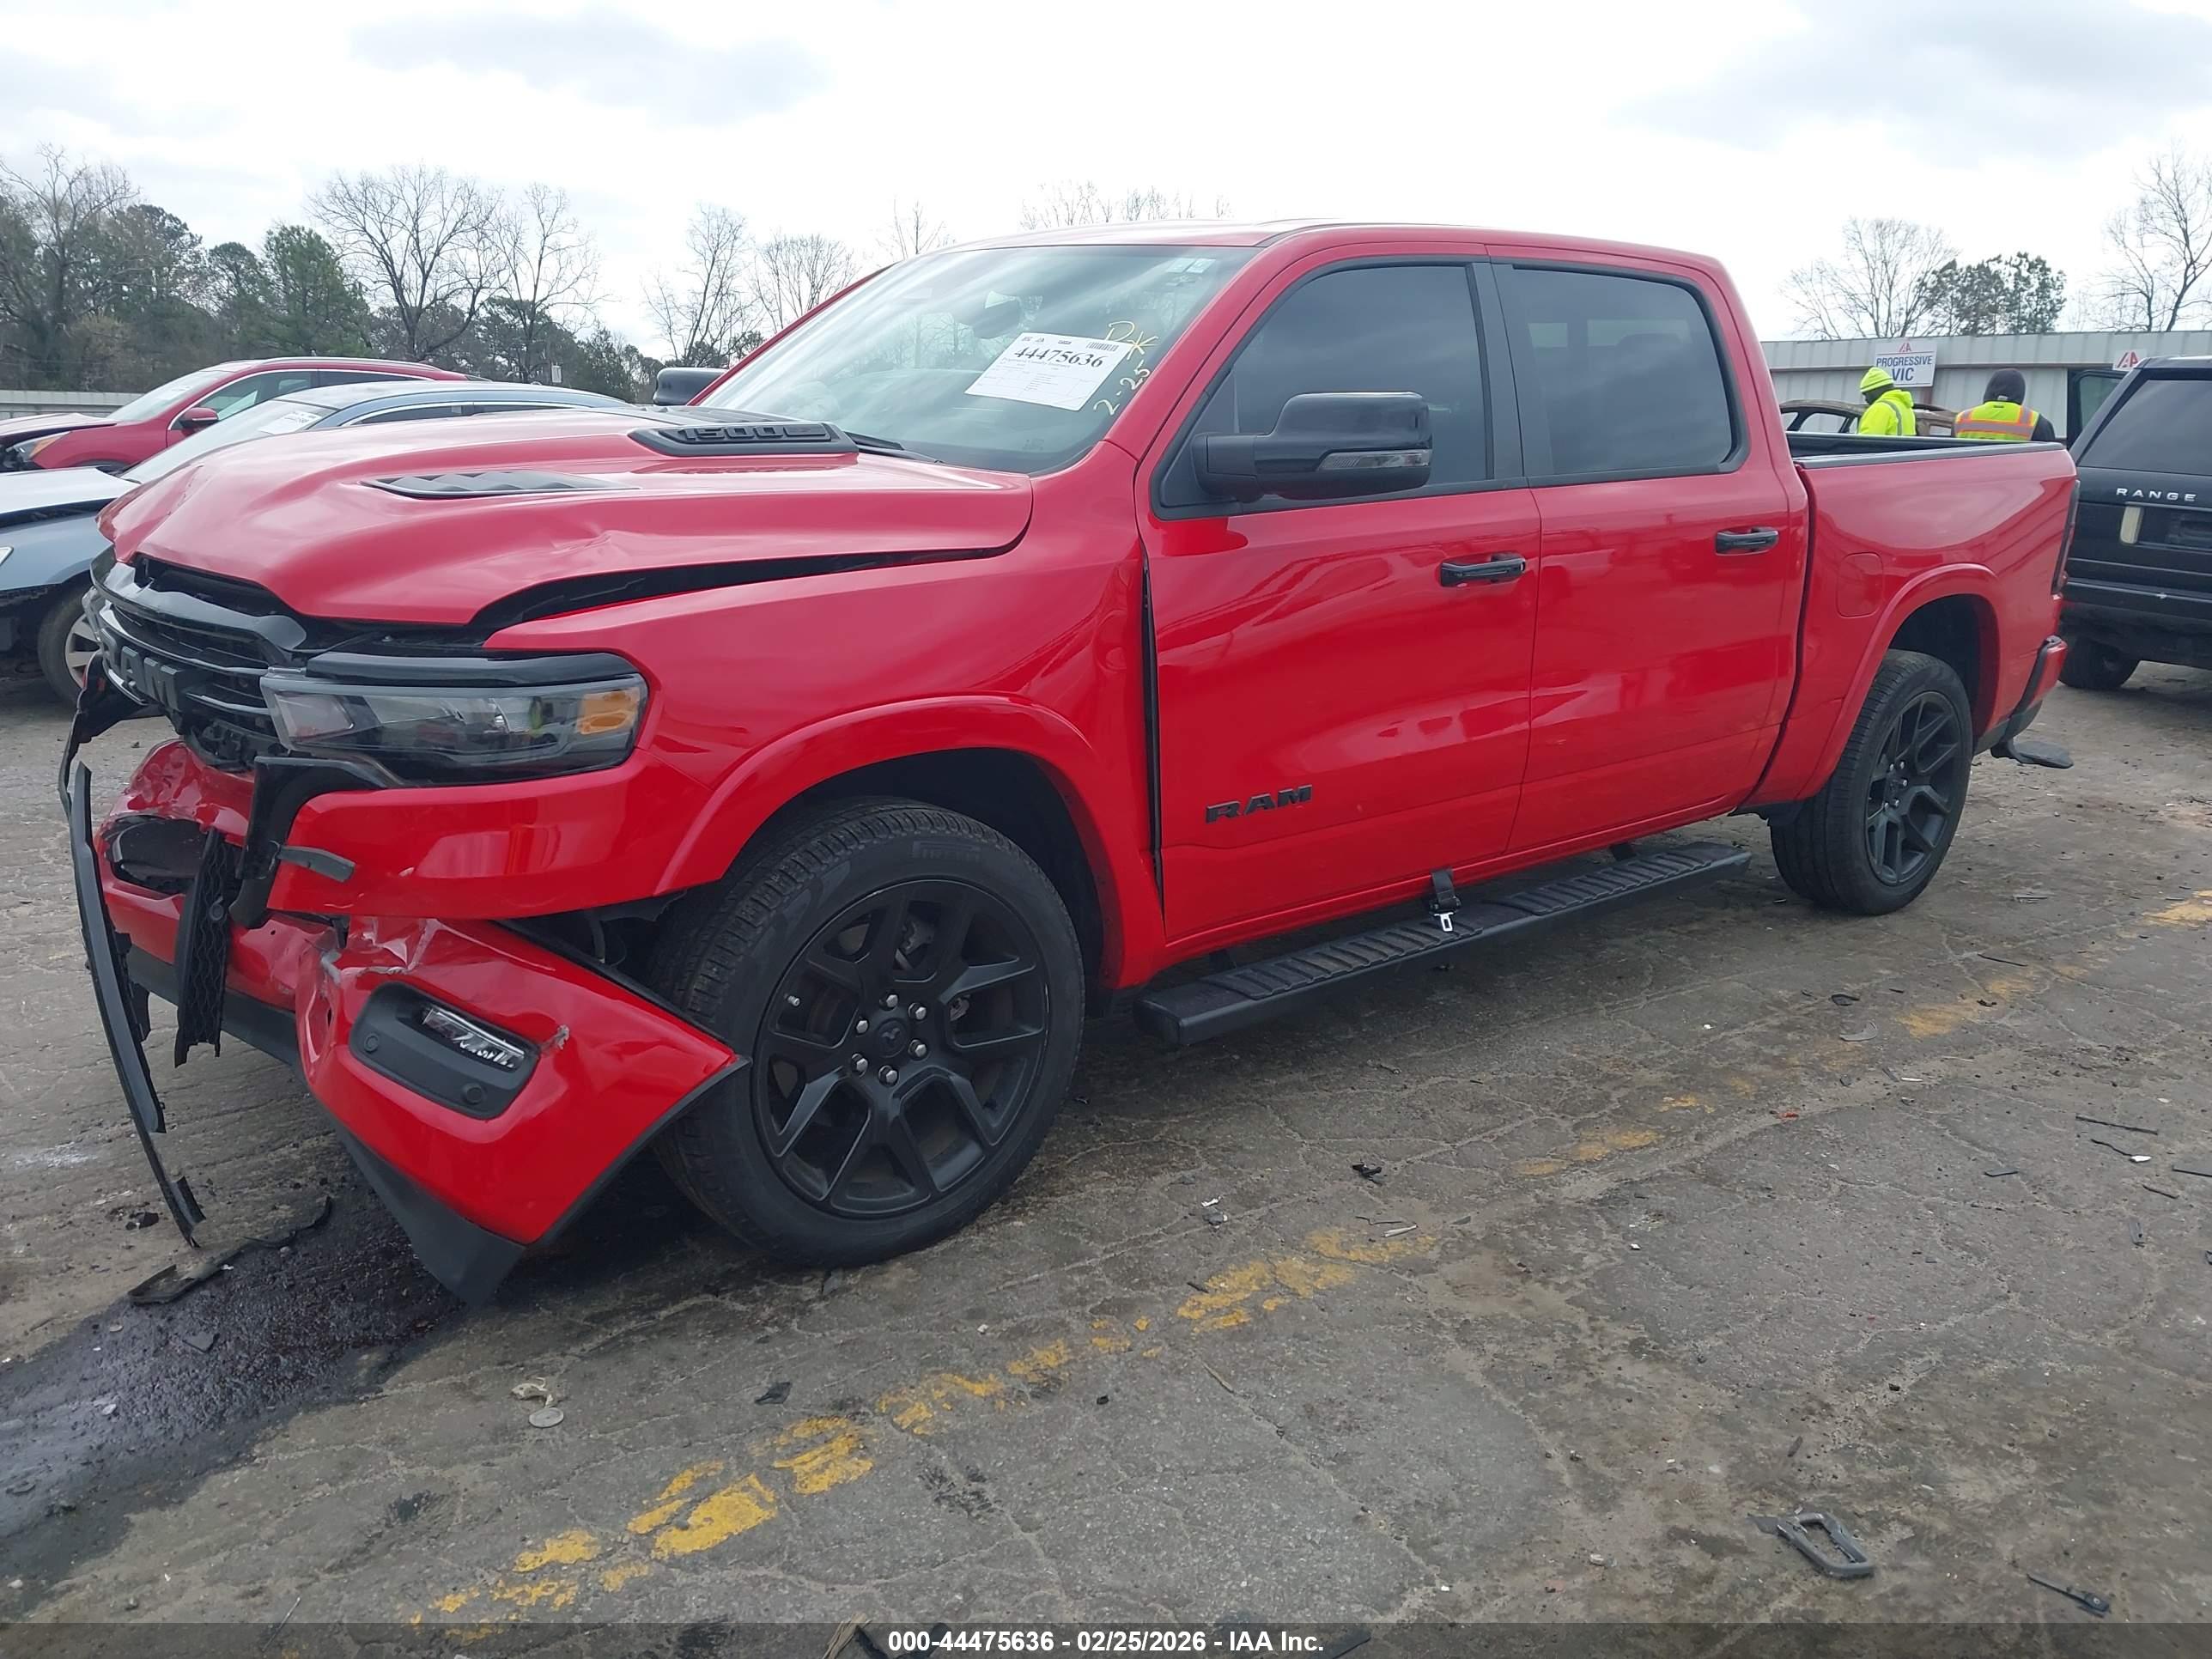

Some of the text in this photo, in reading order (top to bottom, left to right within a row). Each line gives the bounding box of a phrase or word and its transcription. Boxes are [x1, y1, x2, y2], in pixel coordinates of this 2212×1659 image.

[1014, 347, 1109, 368] 44475636
[1876, 355, 1933, 368] PROGRESSIVE
[1892, 368, 1915, 381] VIC
[2116, 487, 2197, 502] RANGE
[1206, 784, 1312, 824] RAM
